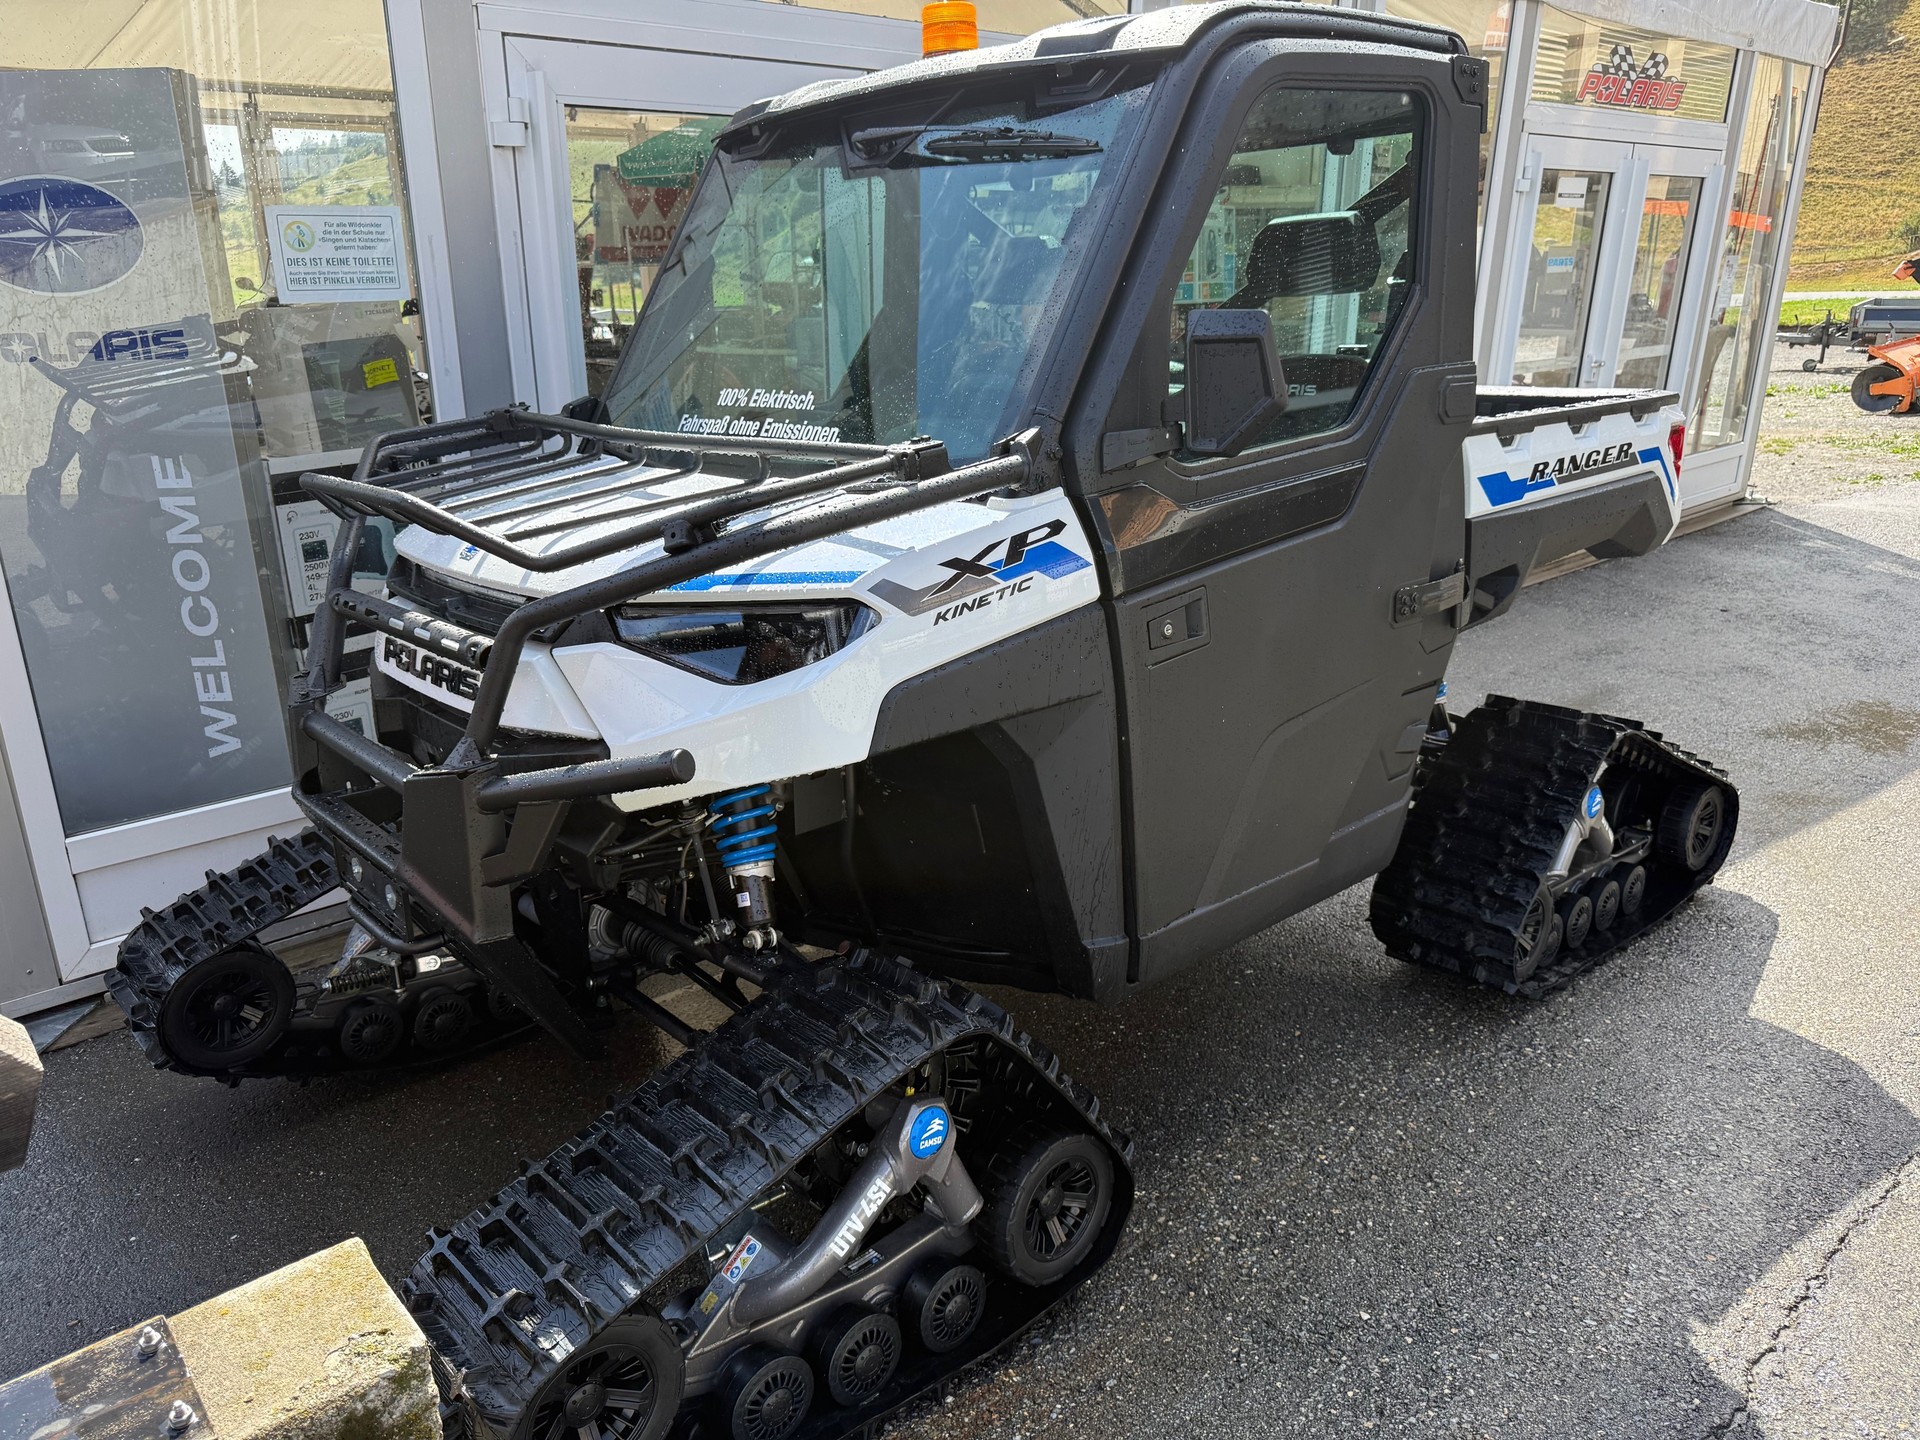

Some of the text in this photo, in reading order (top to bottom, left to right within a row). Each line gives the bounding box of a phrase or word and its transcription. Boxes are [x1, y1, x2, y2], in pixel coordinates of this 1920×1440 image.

[1576, 70, 1688, 111] POLARIS
[286, 257, 395, 267] DIES IST KEINE TOILETTE!
[289, 275, 397, 285] HIER IST PINKELN VERBOTEN!
[716, 388, 815, 411] 100% Elektrisch.
[677, 413, 841, 443] Fahrspaß ohne Emissionen.
[1527, 442, 1633, 483] RANGER
[299, 530, 320, 540] 230V
[921, 518, 1068, 603] XP
[151, 455, 243, 759] WELCOME
[933, 576, 1034, 627] KINETIC
[384, 636, 481, 701] POLARIS
[333, 709, 354, 721] 230V
[920, 1136, 943, 1150] CAMSO
[829, 1213, 866, 1257] UTV
[863, 1177, 893, 1218] 4S1
